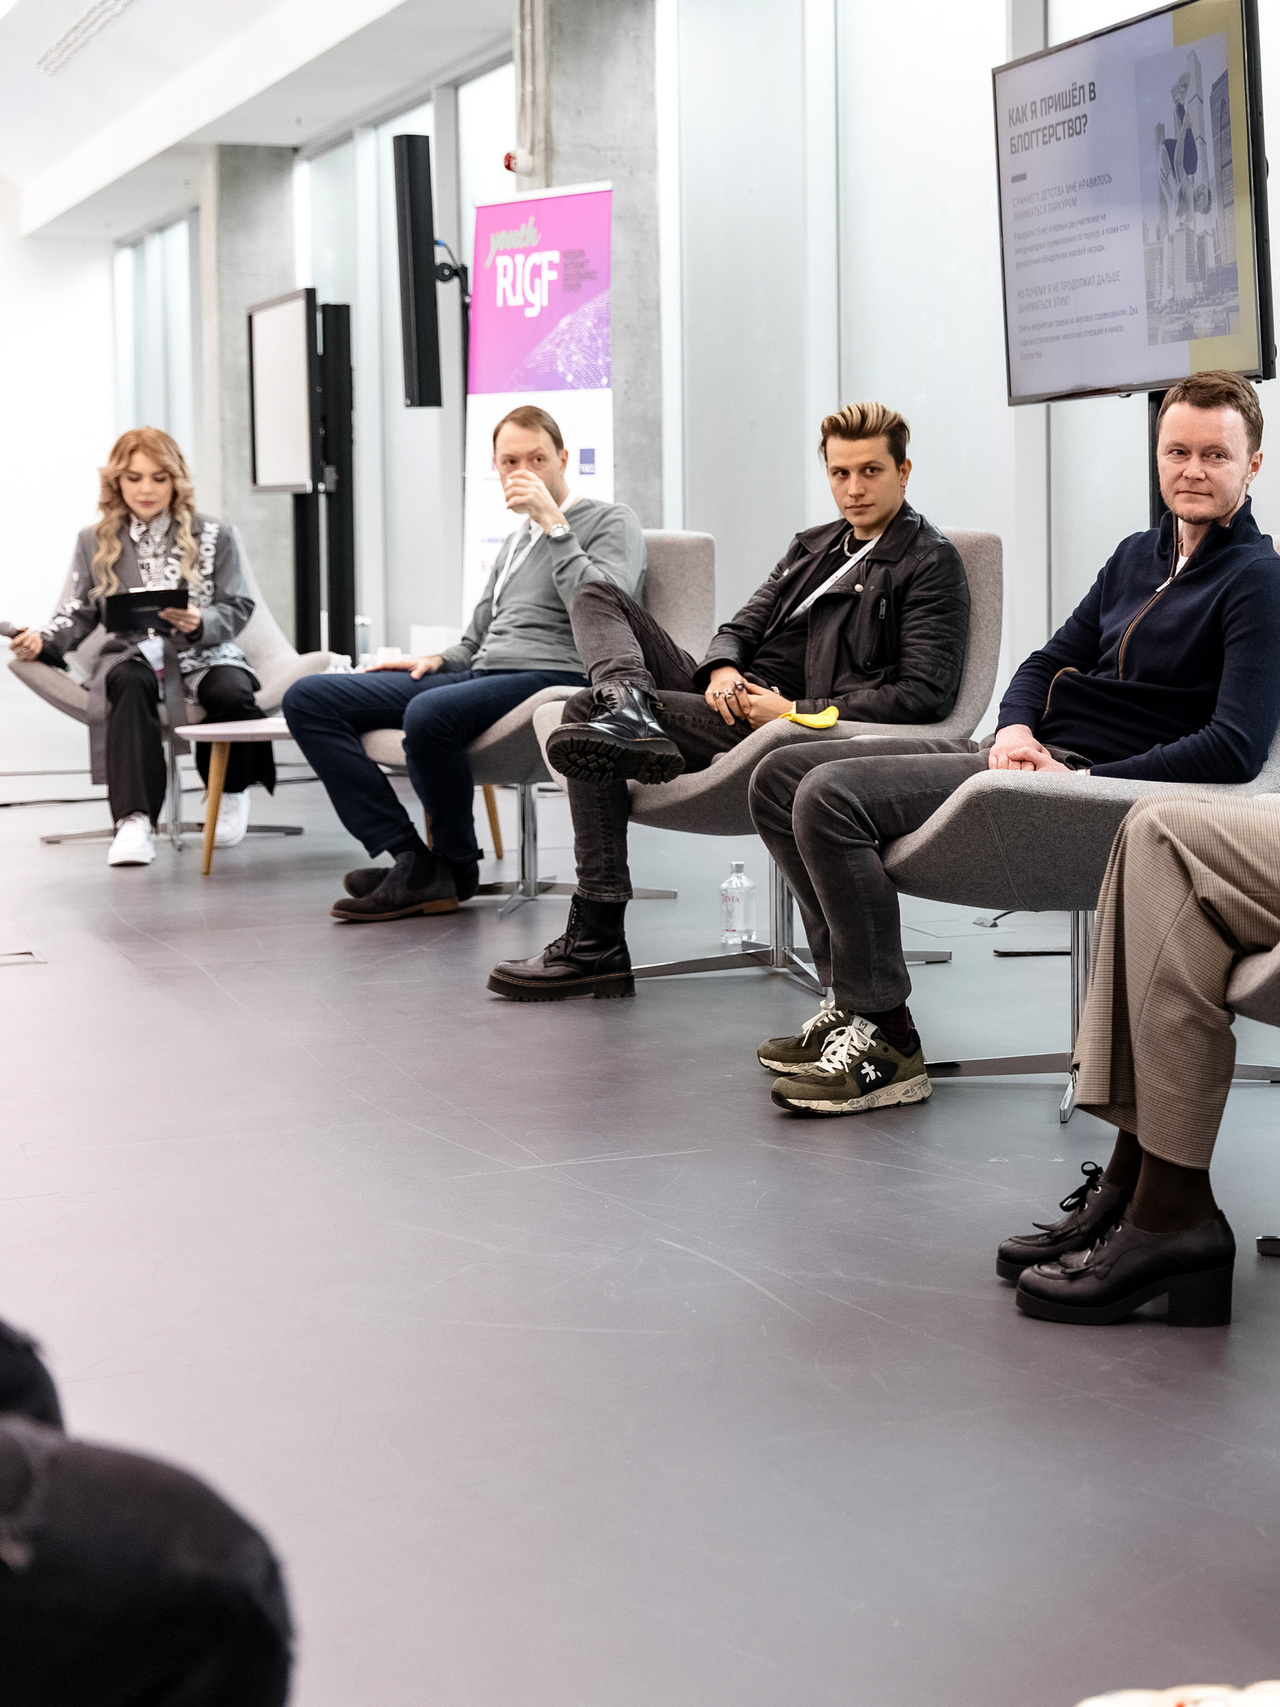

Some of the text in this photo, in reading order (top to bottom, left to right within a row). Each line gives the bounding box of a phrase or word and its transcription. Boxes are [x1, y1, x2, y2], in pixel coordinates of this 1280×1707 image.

[1008, 82, 1096, 127] КАК Я ПРИШЁЛ В
[1010, 114, 1088, 155] БЛОГГЕРСТВО?
[1041, 186, 1064, 200] ДЕТСТВА
[1065, 182, 1077, 193] МНЕ
[1078, 173, 1112, 190] НРАВИЛОСЬ
[1013, 197, 1077, 221] ЗАНИМАТЬСЯ ПАРКУРОМ
[484, 215, 541, 269] youth
[495, 250, 561, 318] RIGF
[1025, 285, 1046, 298] ПОЧЕМУ
[1052, 283, 1059, 292] НЕ
[1060, 275, 1096, 292] ПРОДОЛЖИЛ
[1096, 270, 1121, 285] ДАЛЬШЕ
[1018, 295, 1071, 313] ЗАНИМАТЬСЯ ЭТИМ?
[1129, 306, 1138, 315] Два
